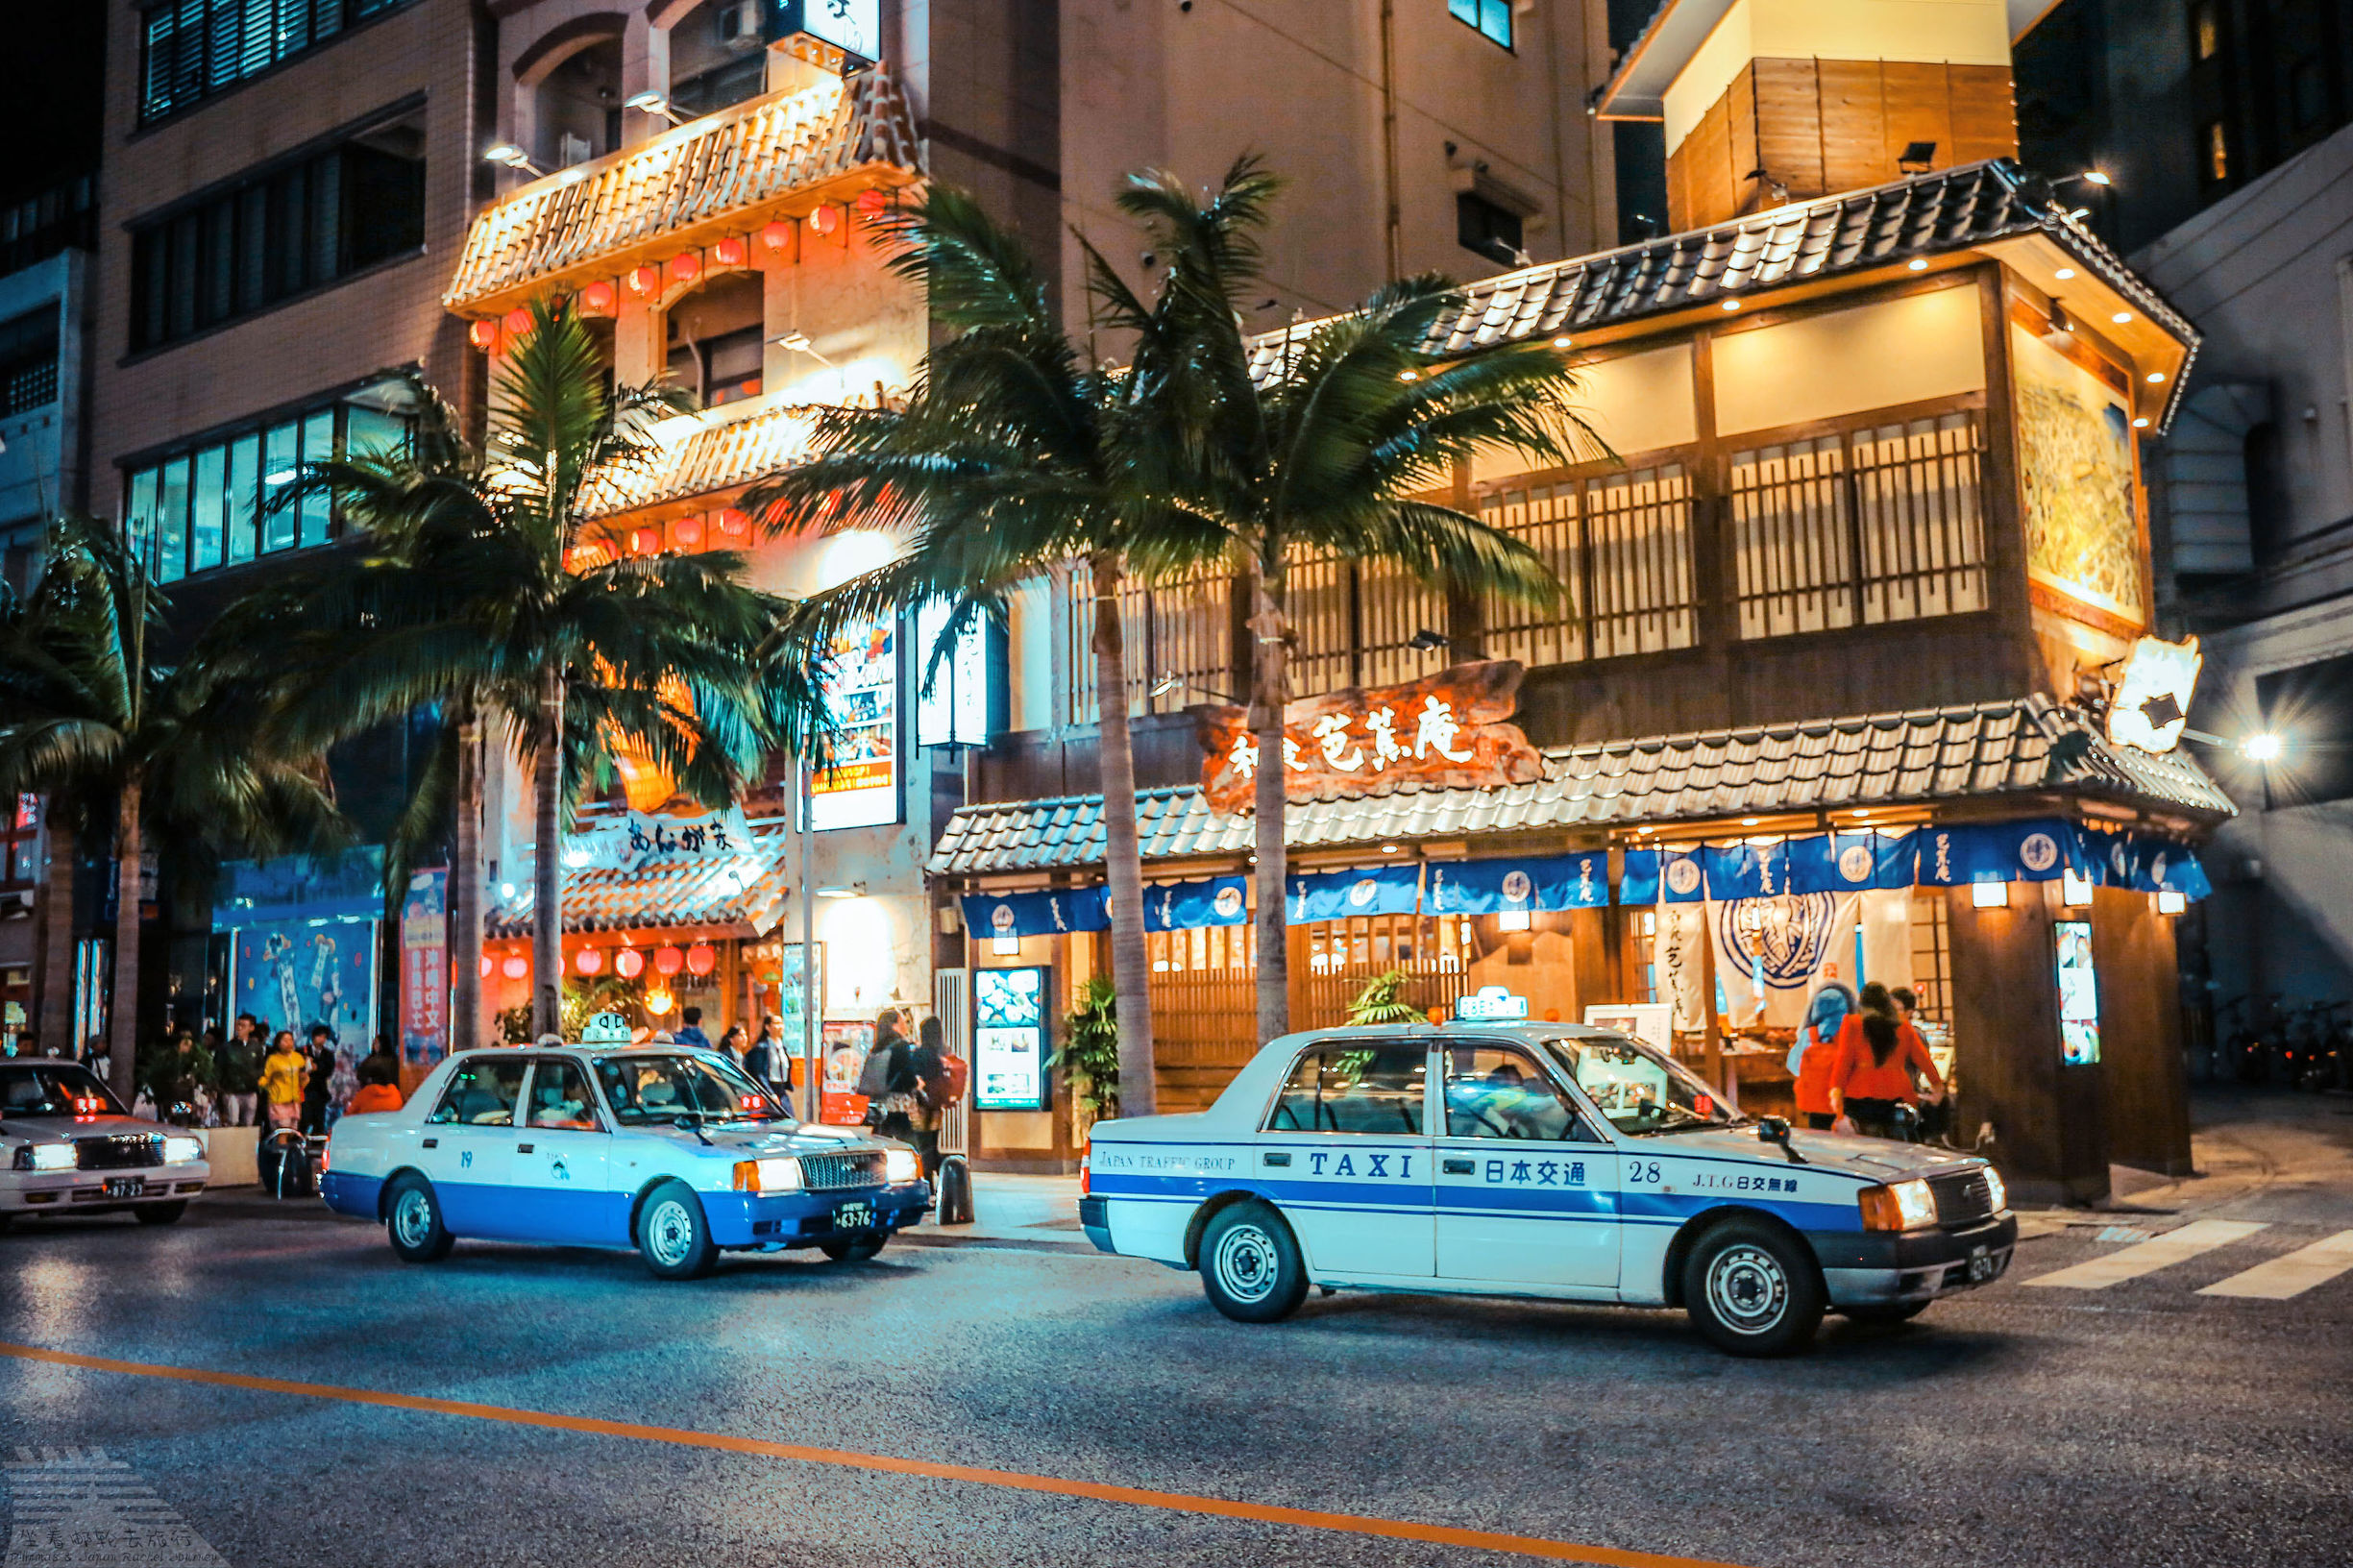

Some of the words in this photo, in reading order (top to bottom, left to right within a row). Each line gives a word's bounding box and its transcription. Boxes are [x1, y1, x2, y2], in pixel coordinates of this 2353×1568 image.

[460, 1151, 472, 1168] 19
[1194, 1157, 1236, 1170] GROUP
[1310, 1152, 1412, 1179] TAXI
[1485, 1160, 1585, 1187] 日本交通
[1629, 1161, 1661, 1184] 28
